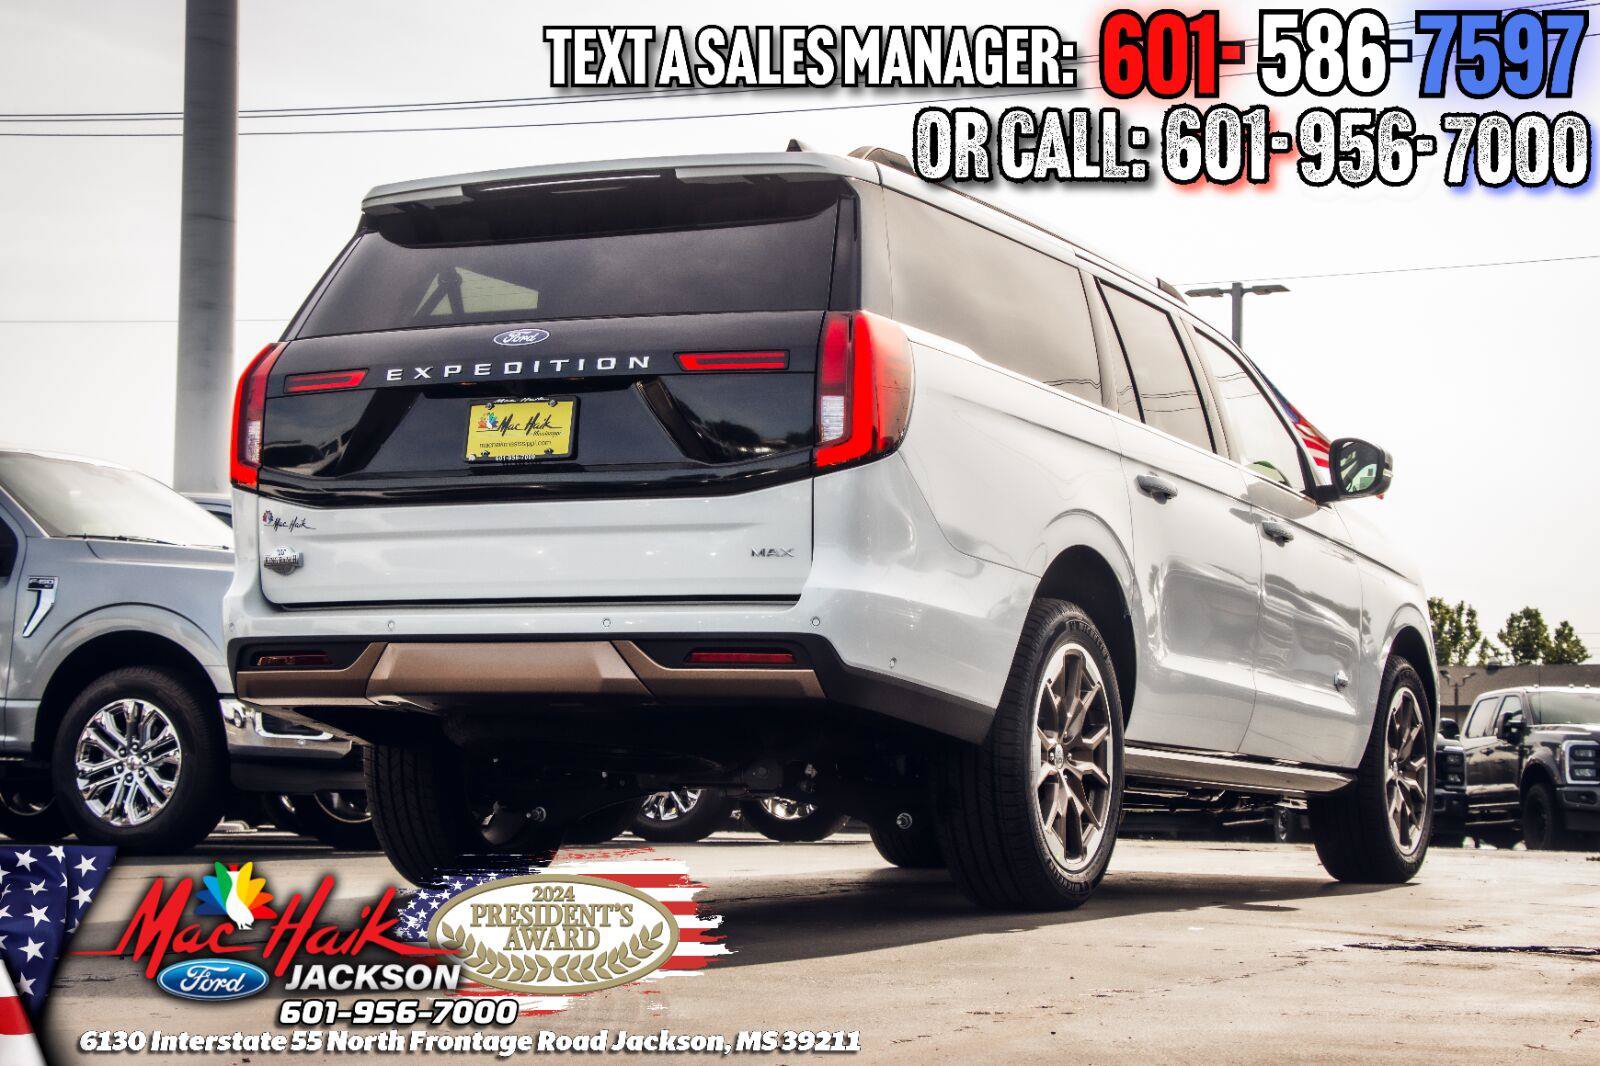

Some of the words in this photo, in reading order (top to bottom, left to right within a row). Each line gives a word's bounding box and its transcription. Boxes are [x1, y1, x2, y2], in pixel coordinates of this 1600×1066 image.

[502, 330, 539, 344] Ford
[386, 356, 650, 381] EXPEDITION
[497, 413, 524, 437] Mac
[523, 412, 563, 436] Haik
[751, 547, 796, 558] MAX
